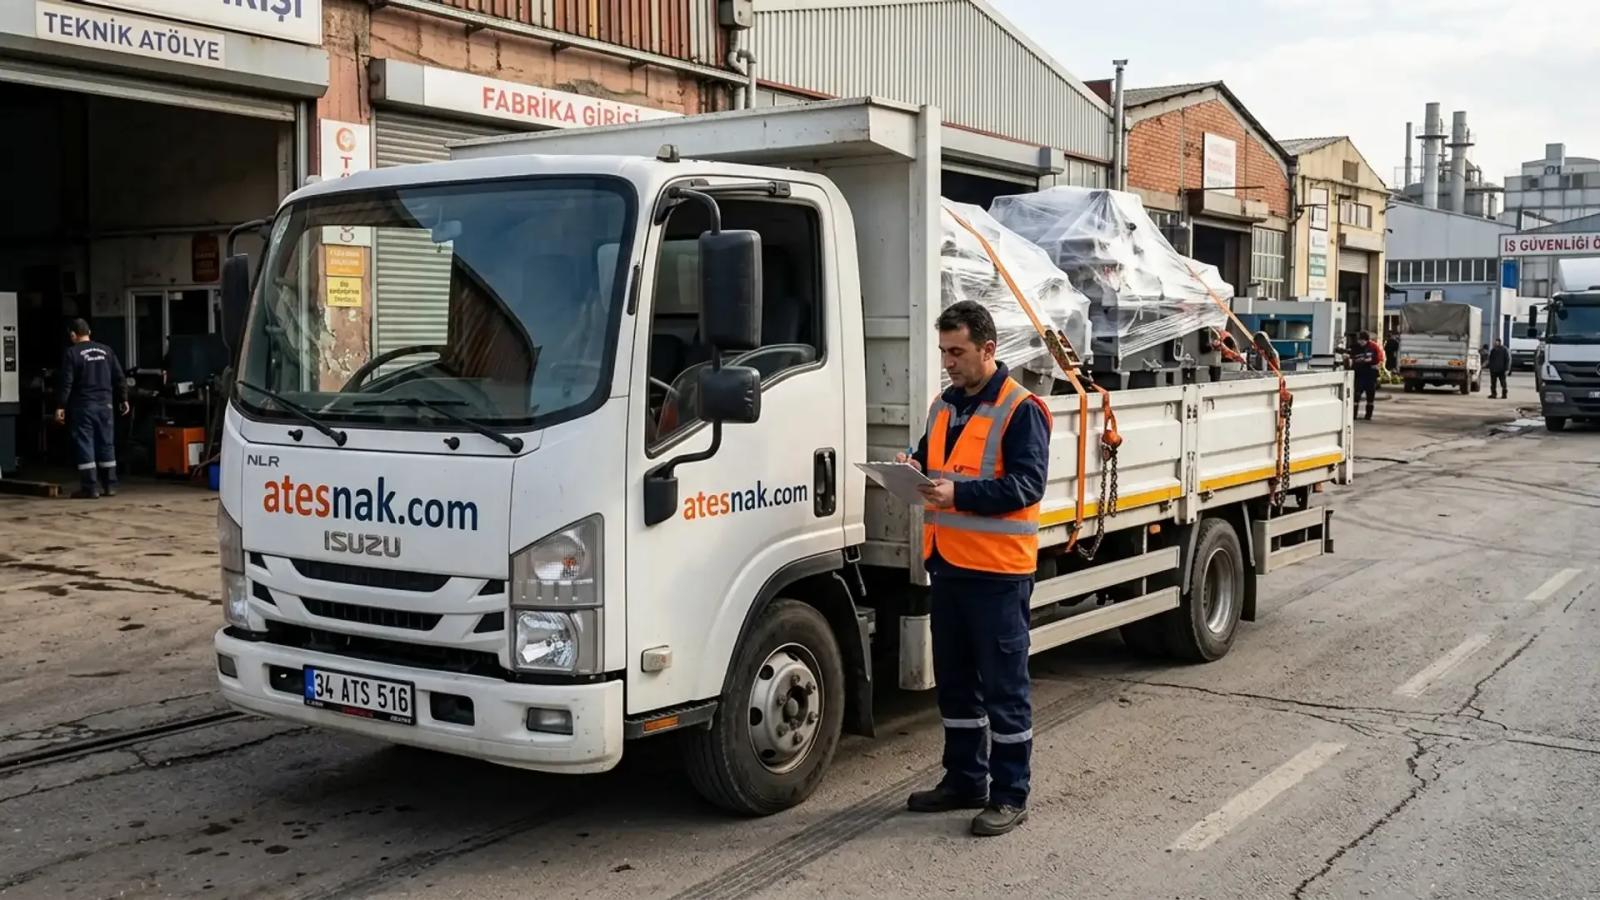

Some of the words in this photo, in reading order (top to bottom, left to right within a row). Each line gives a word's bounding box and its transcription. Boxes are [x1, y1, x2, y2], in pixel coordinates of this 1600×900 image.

[44, 12, 132, 48] TEKNİK
[139, 29, 220, 61] ATÖLYE
[483, 86, 576, 123] FABRİKA
[247, 454, 280, 467] NLR
[263, 475, 478, 530] atesnak.com
[683, 480, 808, 520] atesnak.com
[324, 530, 401, 558] ISUZU
[315, 673, 334, 699] 34
[341, 677, 370, 705] ATS
[377, 683, 409, 712] 516
